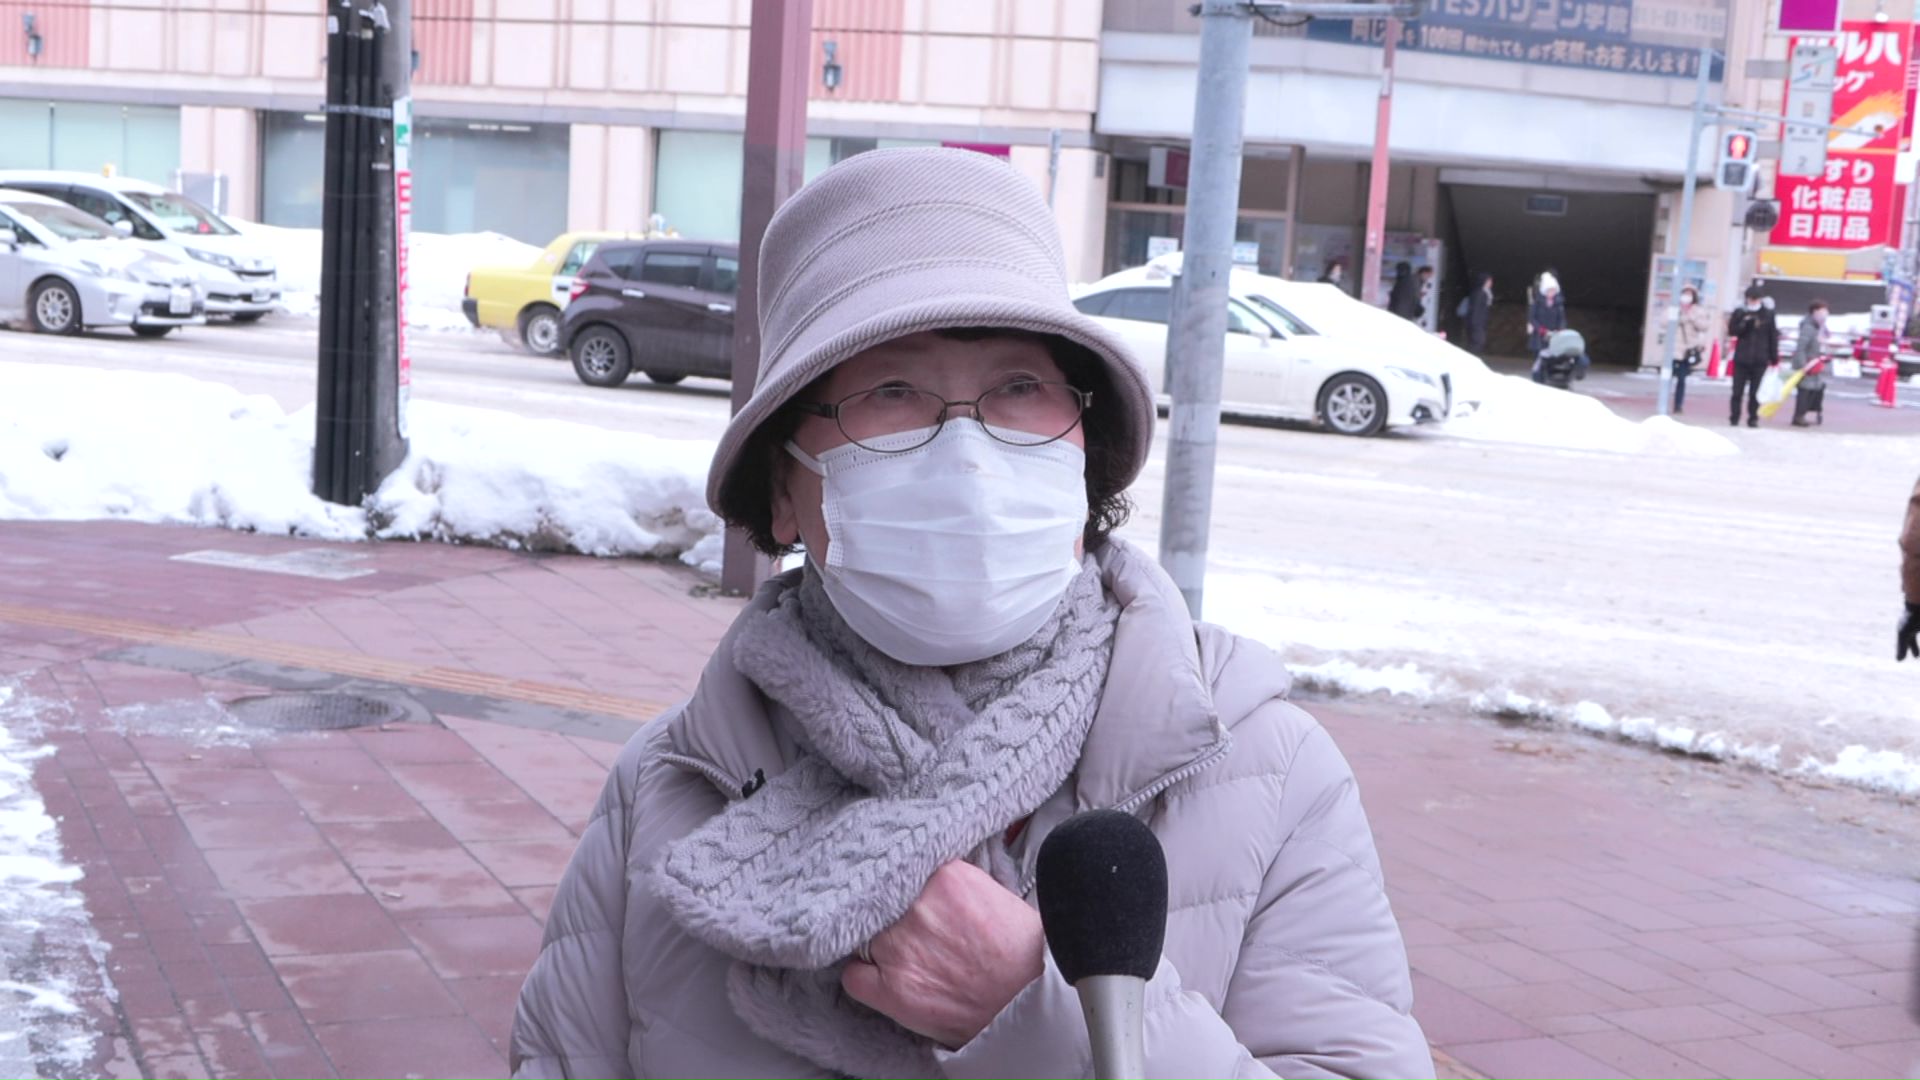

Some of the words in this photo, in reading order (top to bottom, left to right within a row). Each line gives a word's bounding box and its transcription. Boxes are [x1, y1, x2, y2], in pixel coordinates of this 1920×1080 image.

[1797, 31, 1902, 64] ルハ
[1807, 159, 1874, 184] すり
[1792, 185, 1873, 212] 化粧品
[1789, 213, 1871, 241] 日用品
